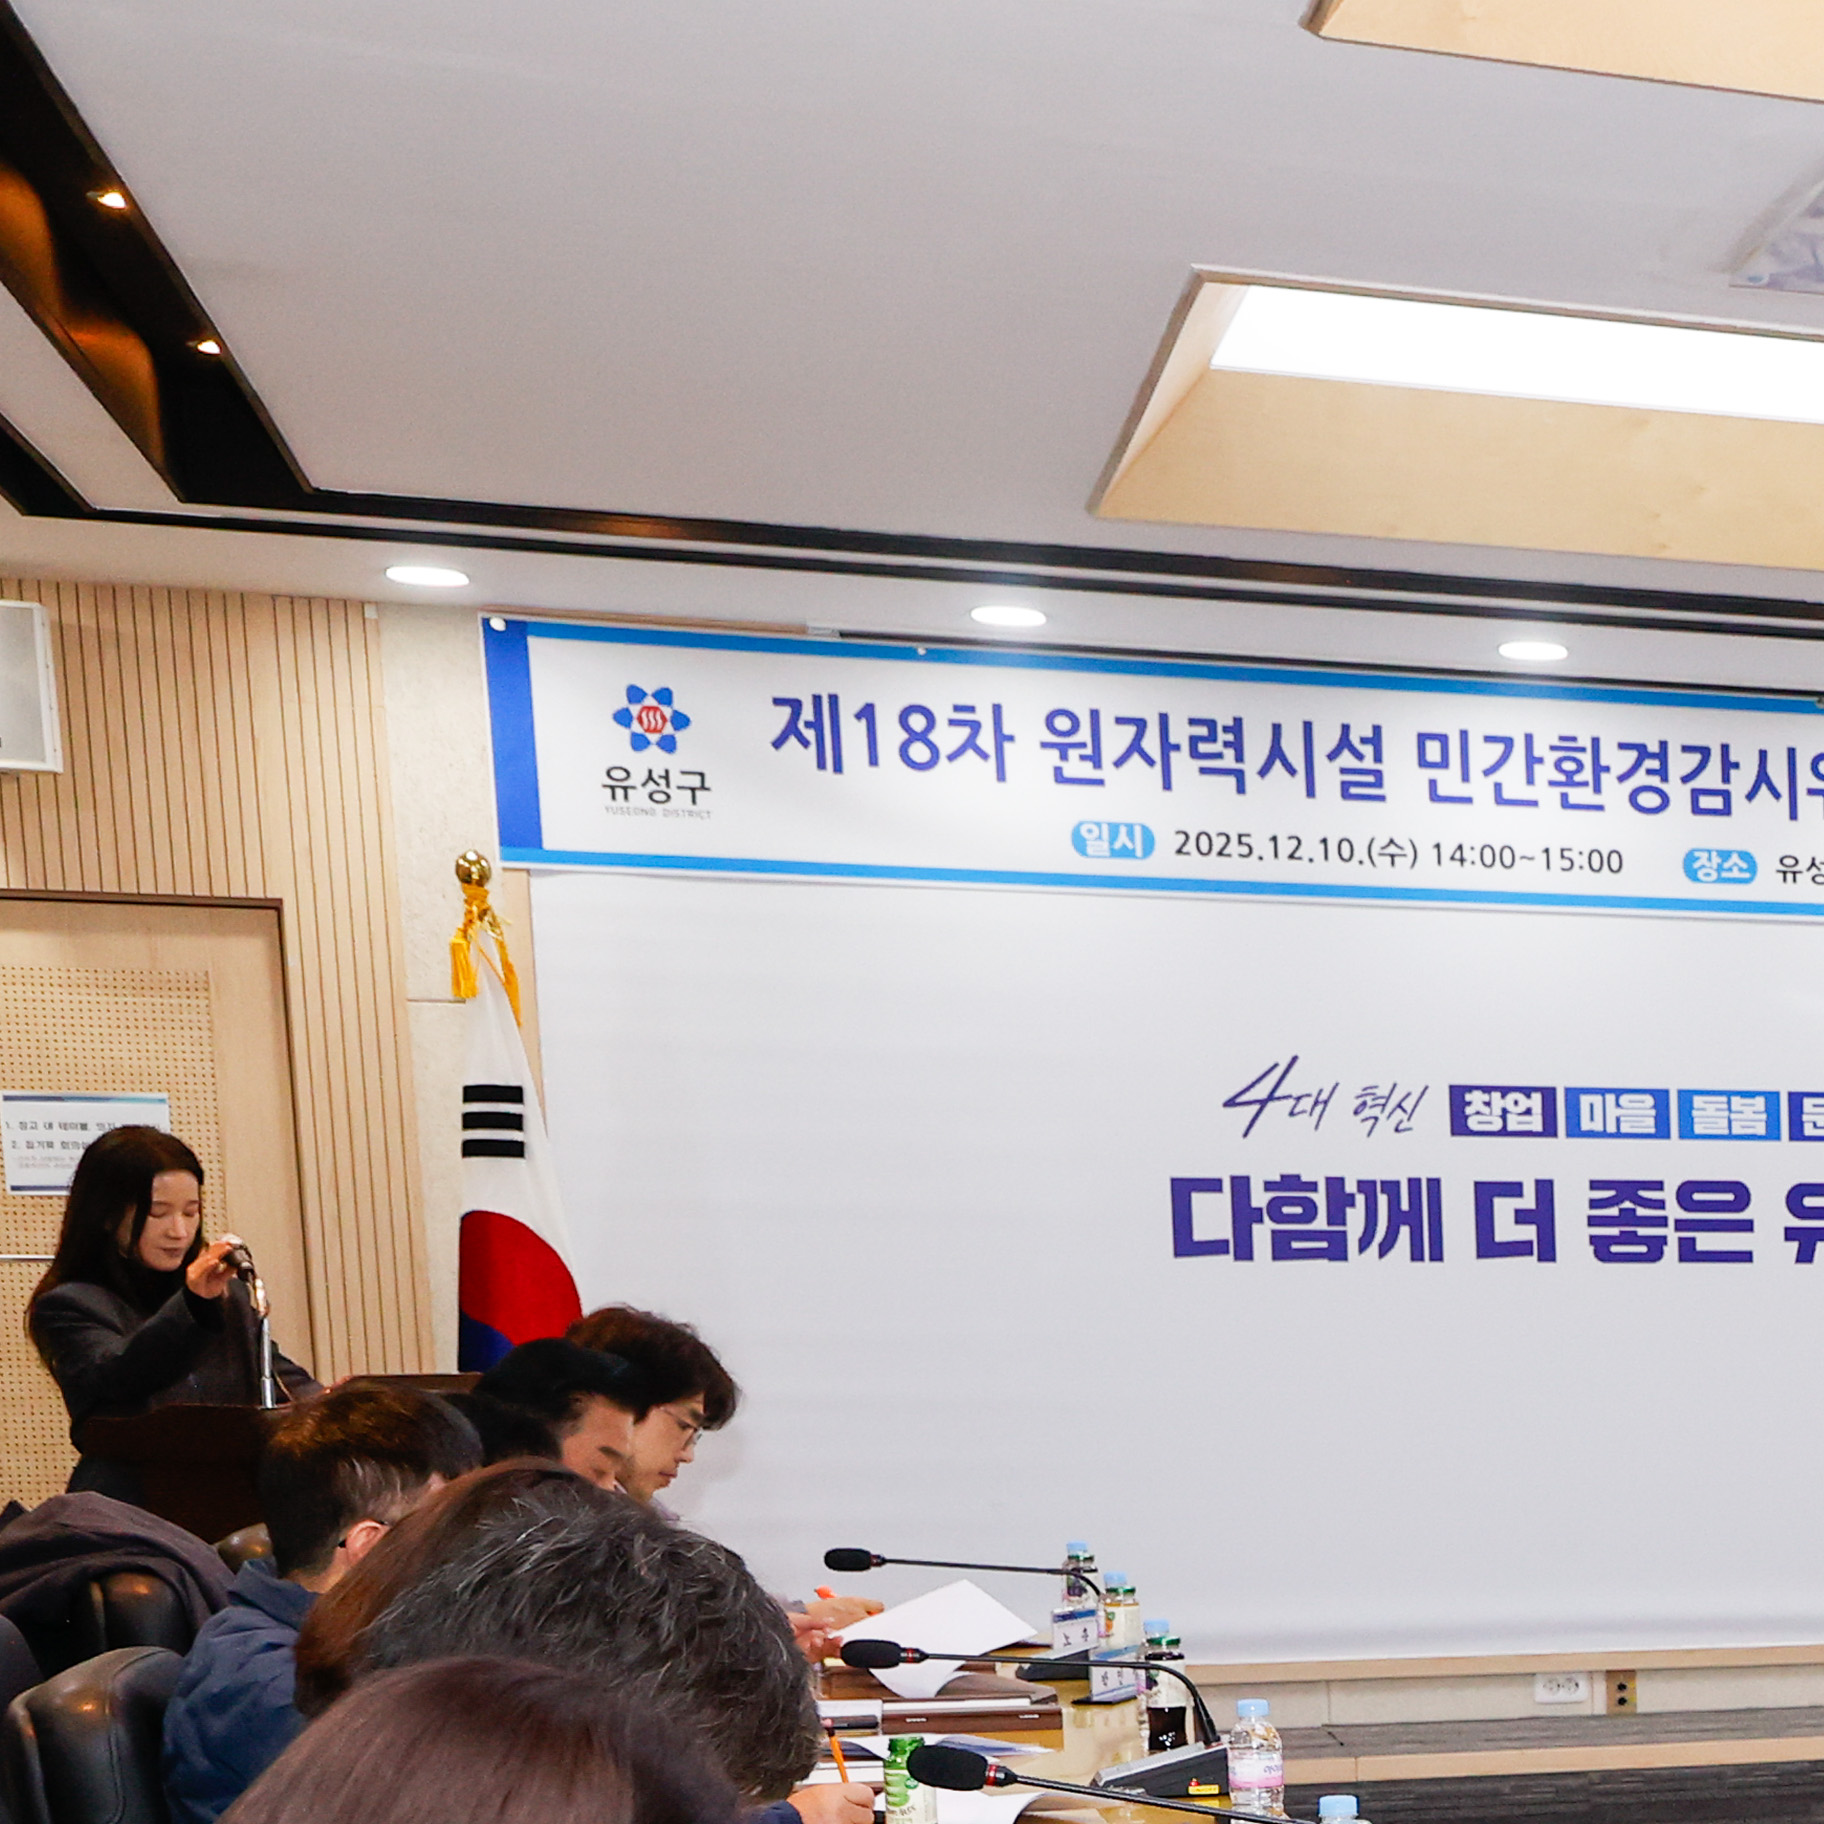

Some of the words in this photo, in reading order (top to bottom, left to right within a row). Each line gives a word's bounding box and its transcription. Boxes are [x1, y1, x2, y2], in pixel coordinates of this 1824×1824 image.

[771, 693, 1015, 783] 제18차
[1040, 708, 1387, 802] 원자력시설
[602, 766, 711, 806] 유성구
[1078, 824, 1144, 858] 일시
[1174, 829, 1418, 867] 2025.12.10.(수)
[1433, 841, 1624, 875] 14:00~15:00
[1692, 849, 1752, 884] 장소
[1222, 1055, 1339, 1139] 4대
[1353, 1082, 1430, 1138] 혁신
[1462, 1091, 1546, 1135] 창업
[1577, 1094, 1657, 1136] 마을
[1690, 1096, 1769, 1137] 돌봄
[1170, 1174, 1444, 1263] 다함께
[1473, 1178, 1557, 1263] 더
[1587, 1179, 1754, 1264] 좋은
